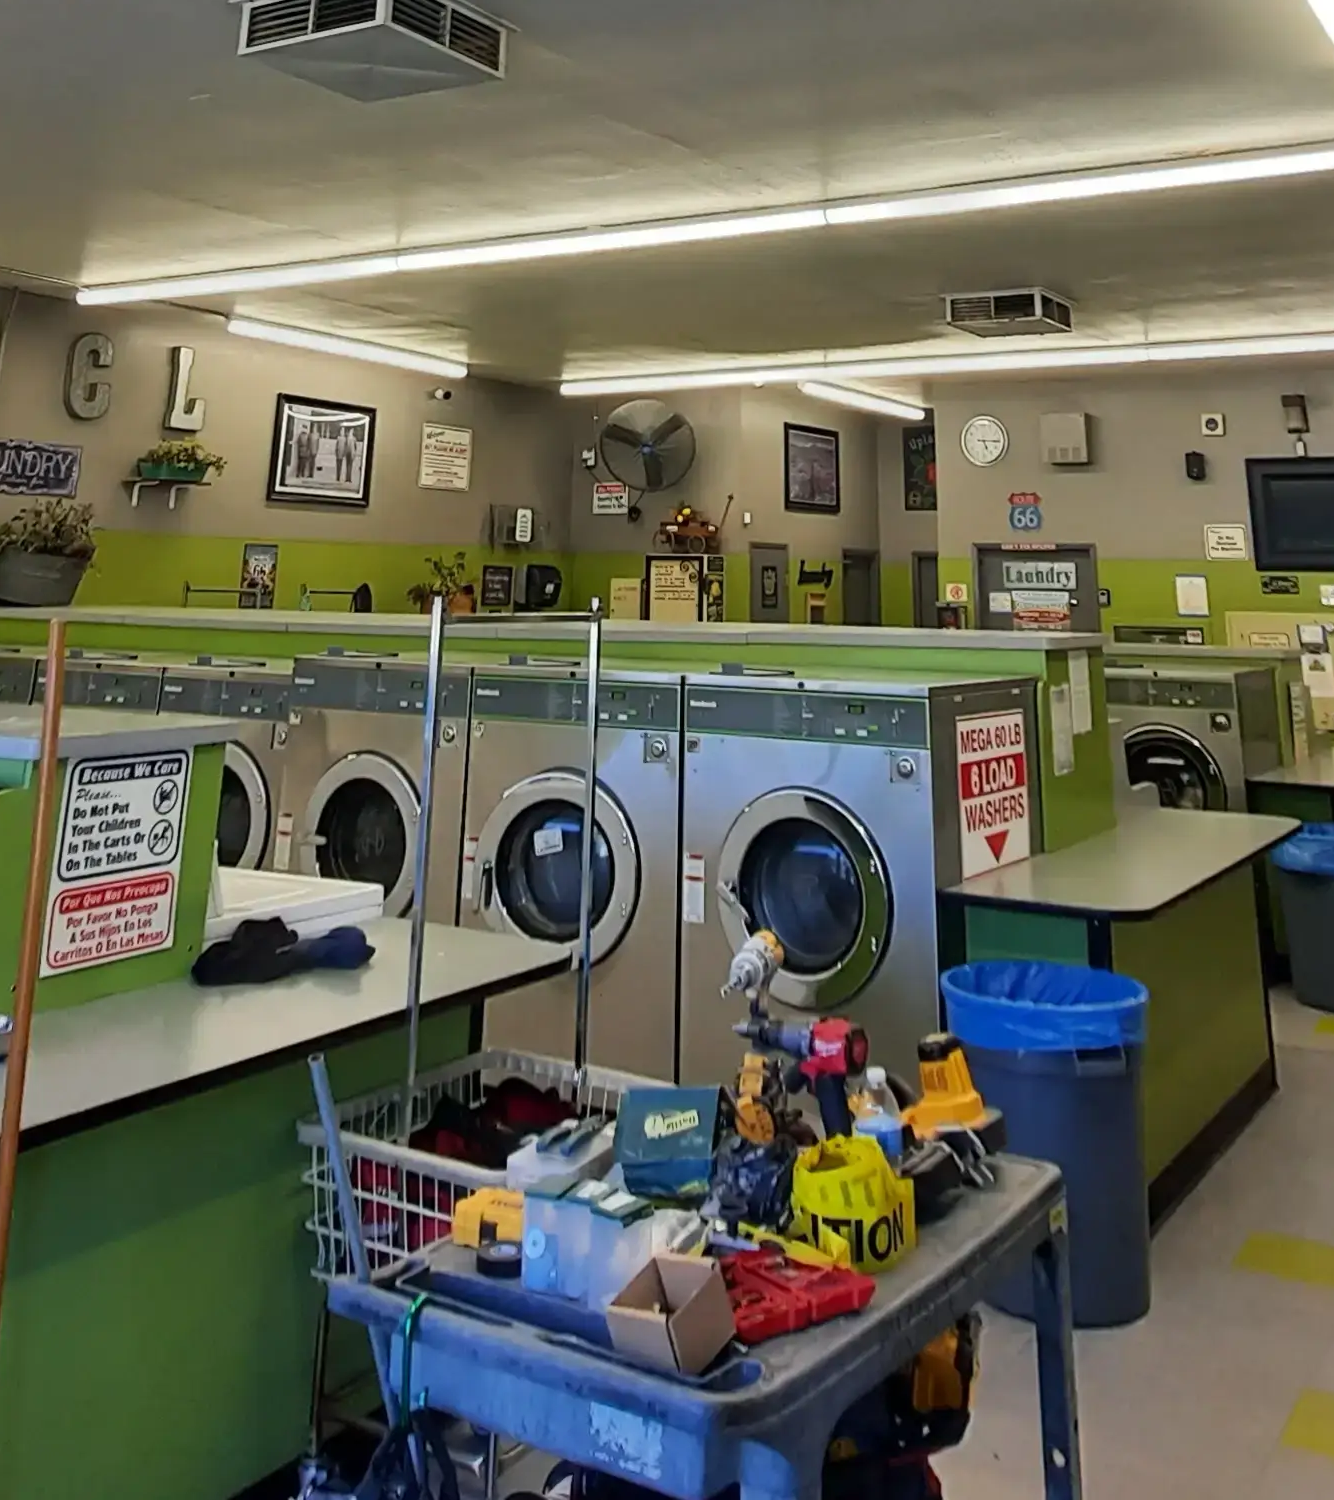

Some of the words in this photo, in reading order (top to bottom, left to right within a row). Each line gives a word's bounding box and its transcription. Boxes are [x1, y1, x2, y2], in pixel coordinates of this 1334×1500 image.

[1013, 506, 1038, 529] 66
[1005, 564, 1073, 588] Laundry
[960, 727, 993, 754] MEGA
[995, 726, 1008, 748] 60
[1009, 723, 1022, 746] LB
[81, 765, 130, 783] Because
[134, 763, 153, 778] We
[154, 760, 180, 775] Care
[983, 757, 1017, 794] LOAD
[72, 806, 87, 820] Do
[89, 804, 109, 818] Not
[112, 802, 130, 815] Put
[964, 793, 1025, 834] WASHERS
[71, 823, 95, 838] Your
[98, 817, 142, 833] Children
[67, 842, 79, 855] In
[80, 838, 101, 853] The
[103, 834, 131, 850] Carts
[133, 831, 146, 845] Or
[65, 858, 81, 872] On
[83, 855, 103, 870] The
[106, 850, 138, 866] Tables
[62, 895, 81, 911] Por
[83, 892, 102, 907] Que
[123, 879, 168, 899] Preocupa
[66, 916, 85, 930] Por
[86, 909, 113, 925] Favor
[115, 906, 128, 920] No
[130, 901, 159, 917] Ponga
[69, 931, 77, 944] A
[79, 928, 96, 942] Sus
[98, 923, 122, 939] Hijos
[123, 920, 135, 933] En
[137, 918, 153, 931] Los
[53, 945, 93, 964] Carritos
[95, 941, 104, 954] O
[106, 939, 117, 952] En
[119, 935, 135, 950] Las
[137, 929, 164, 945] Mesas
